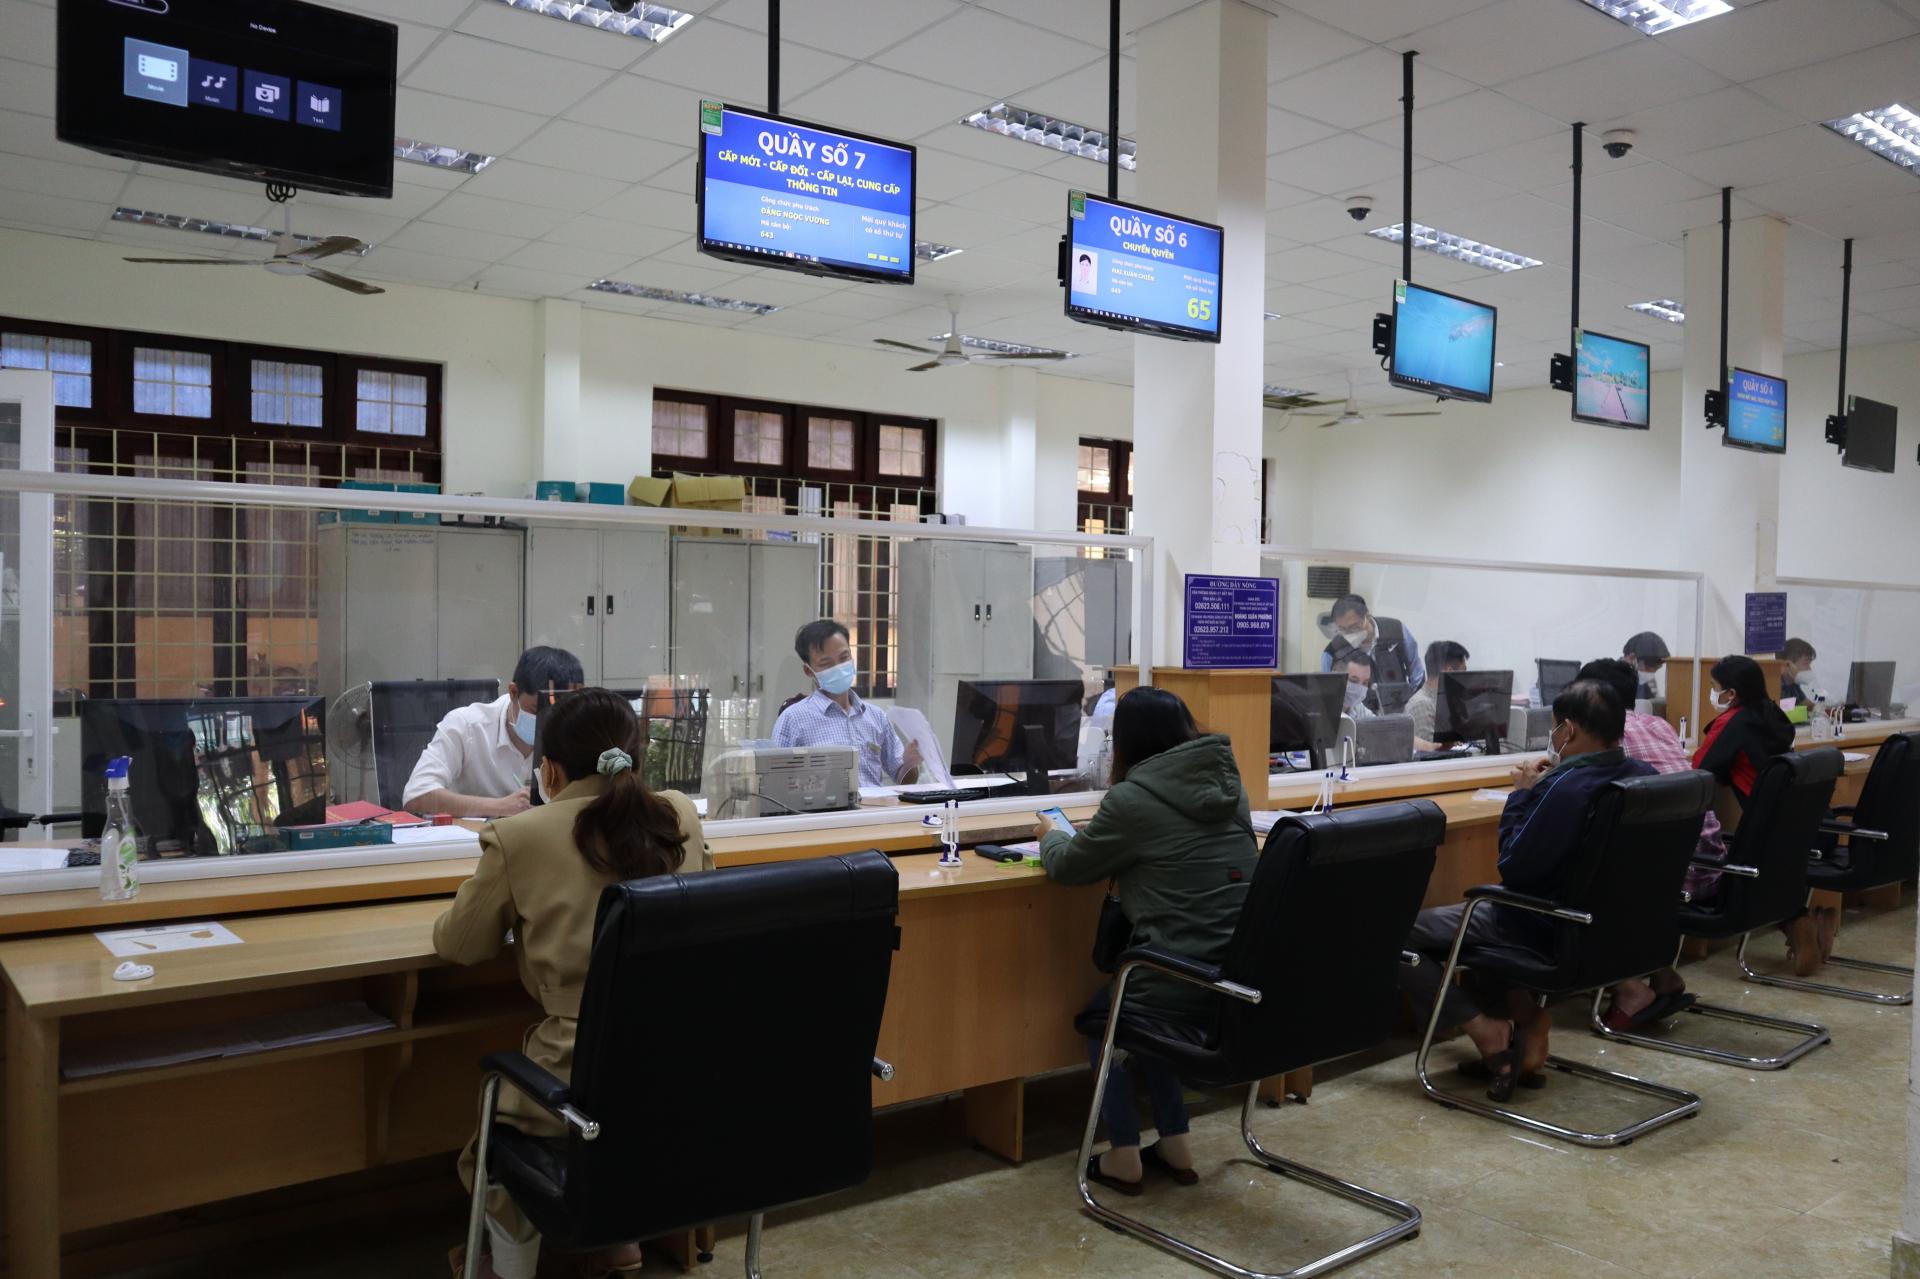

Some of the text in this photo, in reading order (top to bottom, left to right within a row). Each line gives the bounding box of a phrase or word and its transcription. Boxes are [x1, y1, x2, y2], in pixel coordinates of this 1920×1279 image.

[258, 24, 277, 34] Device
[258, 106, 274, 115] Photo
[312, 116, 324, 124] Text
[758, 131, 866, 170] QUẦY SỐ 7
[718, 150, 738, 163] CẤP
[740, 154, 761, 168] MỚI
[769, 158, 788, 172] CẤP
[817, 169, 836, 182] CẤP
[856, 178, 882, 192] CUNG
[883, 181, 900, 195] CẤP
[786, 177, 838, 198] THÔNG TIN
[760, 231, 774, 240] 643
[1110, 215, 1188, 248] QUẦY SỐ 6
[1187, 297, 1211, 320] 65
